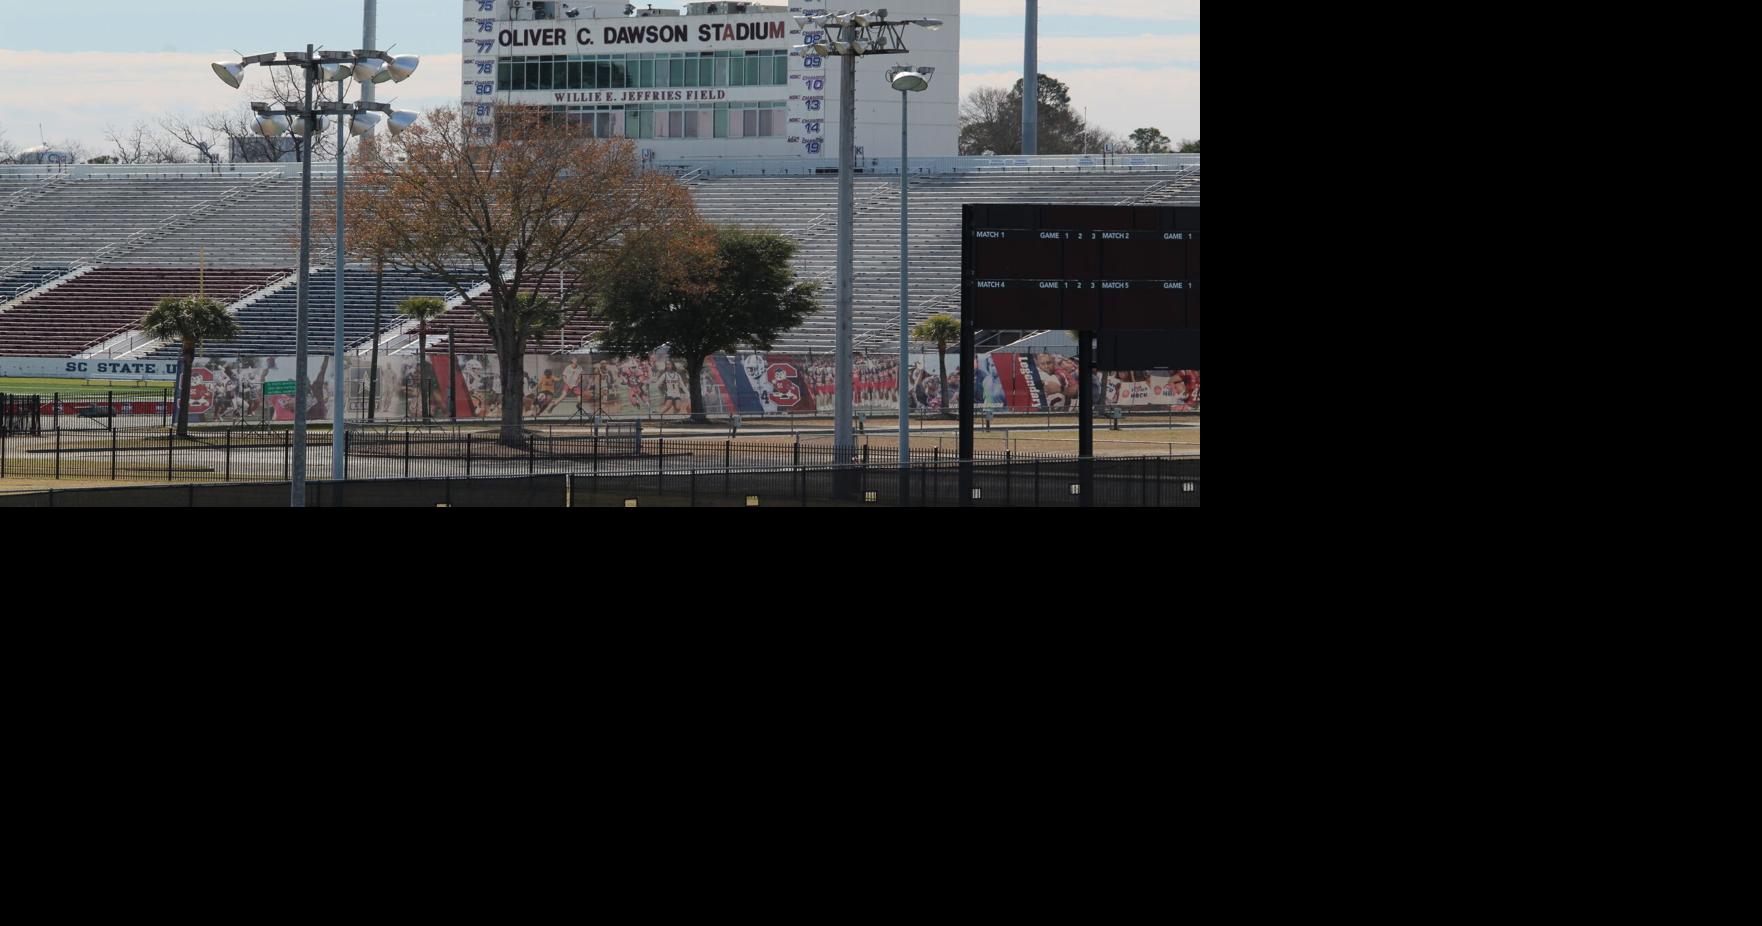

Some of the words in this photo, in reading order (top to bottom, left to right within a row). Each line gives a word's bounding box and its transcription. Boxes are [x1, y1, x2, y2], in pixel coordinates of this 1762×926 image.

[478, 1, 493, 11] 75
[478, 22, 493, 32] 76
[499, 28, 566, 47] OLIVER
[577, 27, 594, 46] C.
[604, 24, 688, 45] DAWSON
[698, 21, 785, 42] STADIUM
[477, 42, 493, 53] 77
[804, 57, 820, 67] 09
[477, 64, 492, 74] 78
[476, 84, 492, 95] 80
[805, 80, 823, 90] 10
[554, 92, 602, 102] WILLIE
[606, 92, 617, 102] E.
[621, 91, 682, 101] JEFFRIES
[686, 90, 726, 100] FIELD
[805, 100, 820, 111] 13
[804, 123, 820, 134] 14
[805, 143, 820, 154] 19
[65, 362, 88, 372] SC
[97, 362, 156, 374] STATE
[1018, 356, 1041, 409] Legendary
